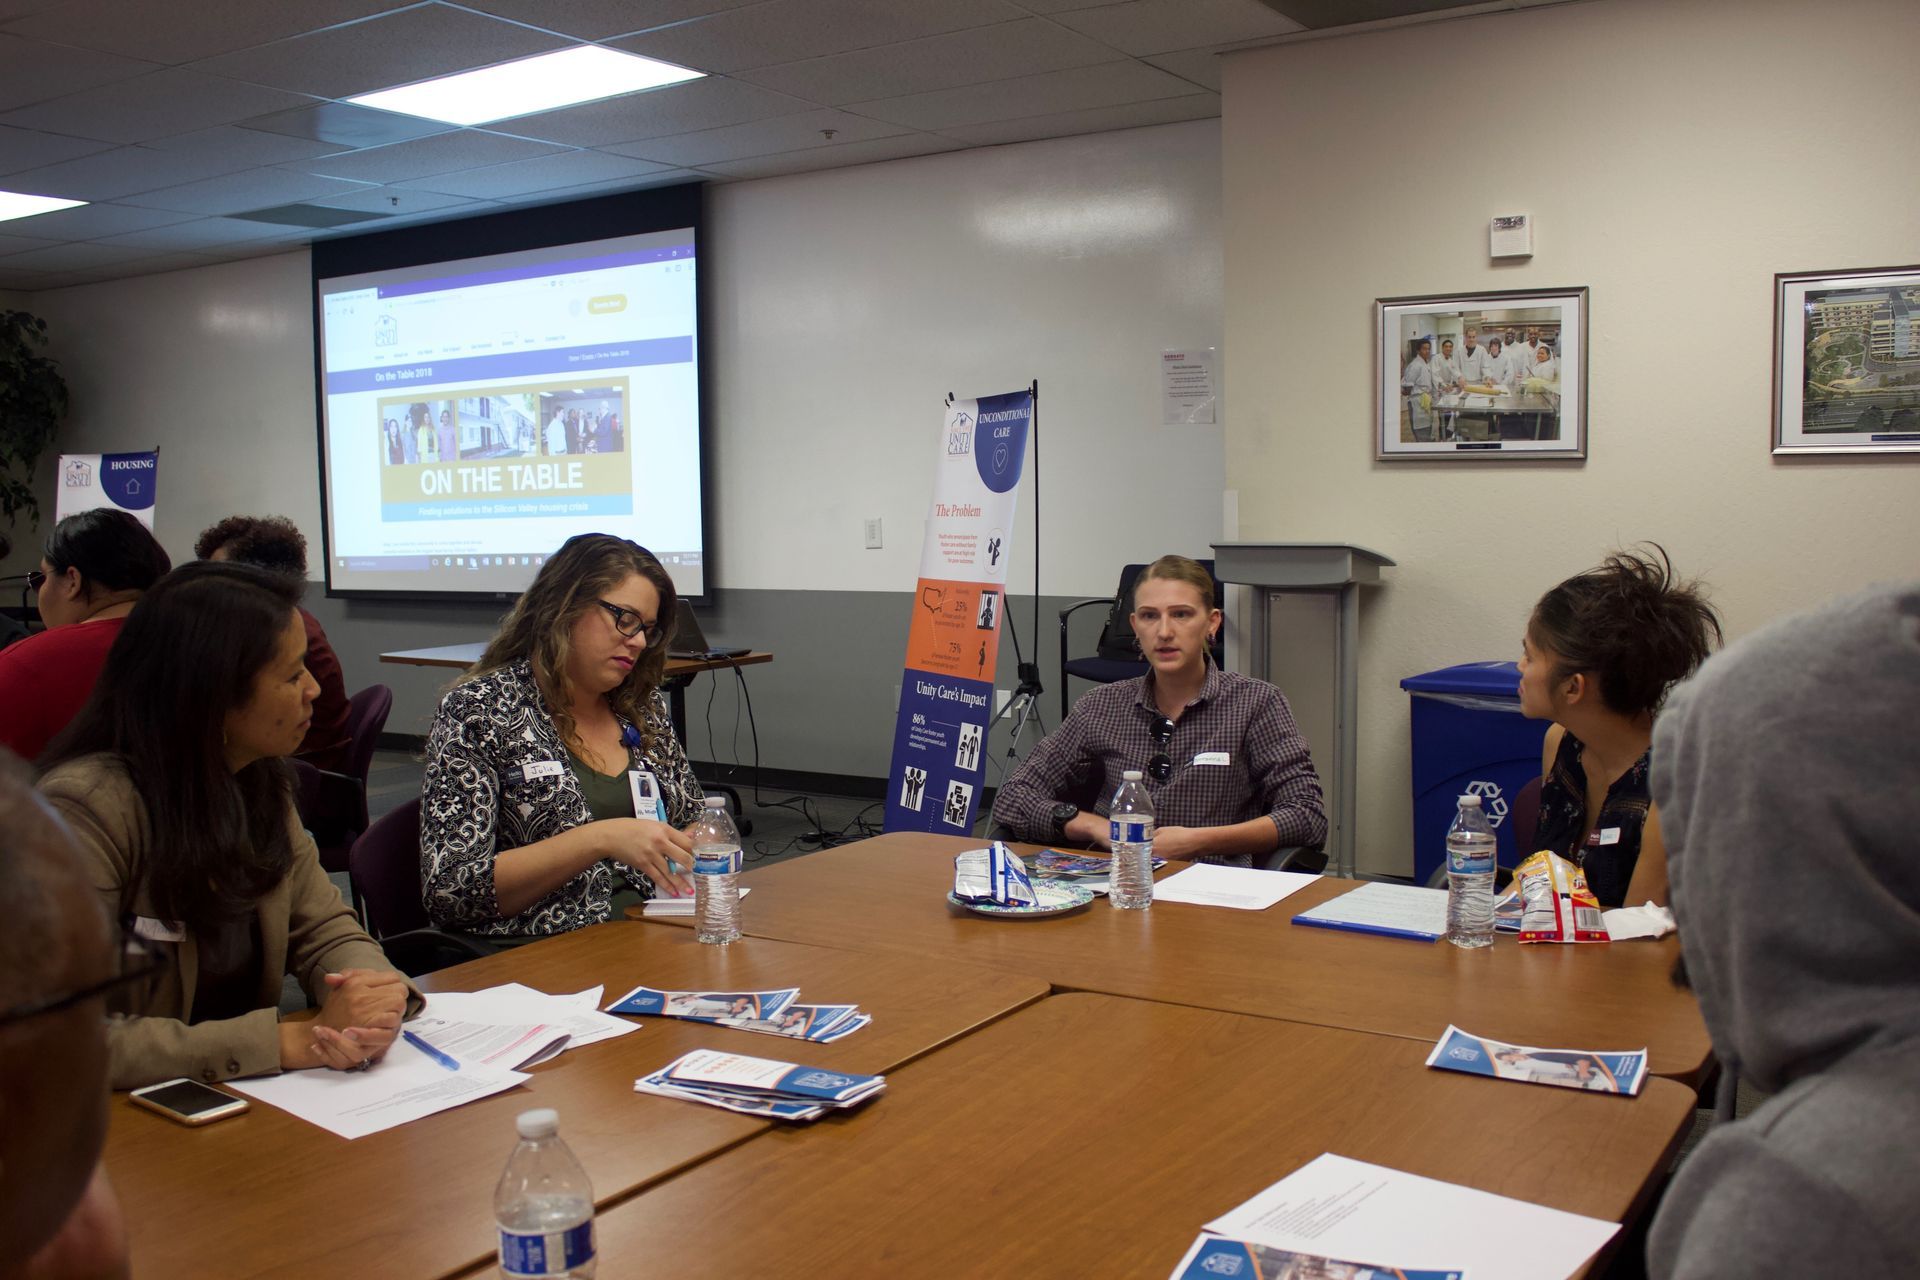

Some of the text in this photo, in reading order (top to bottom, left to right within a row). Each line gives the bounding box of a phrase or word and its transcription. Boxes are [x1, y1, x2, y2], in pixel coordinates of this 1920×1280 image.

[375, 367, 432, 382] On the Table 2018
[979, 407, 1030, 424] UNCONDITIONAL
[993, 427, 1011, 438] CARE
[111, 459, 154, 470] HOUSING
[420, 462, 583, 496] ON THE TABLE
[481, 505, 492, 514] the
[494, 504, 517, 514] Silicon
[518, 504, 537, 515] Valley
[538, 503, 567, 514] housing
[568, 501, 589, 512] crisis
[935, 504, 981, 517] The Problem
[955, 600, 968, 612] 25%
[949, 641, 961, 654] 75%
[916, 680, 987, 708] Unity Care's Impact
[912, 713, 926, 725] 86%
[531, 765, 554, 775] Julie
